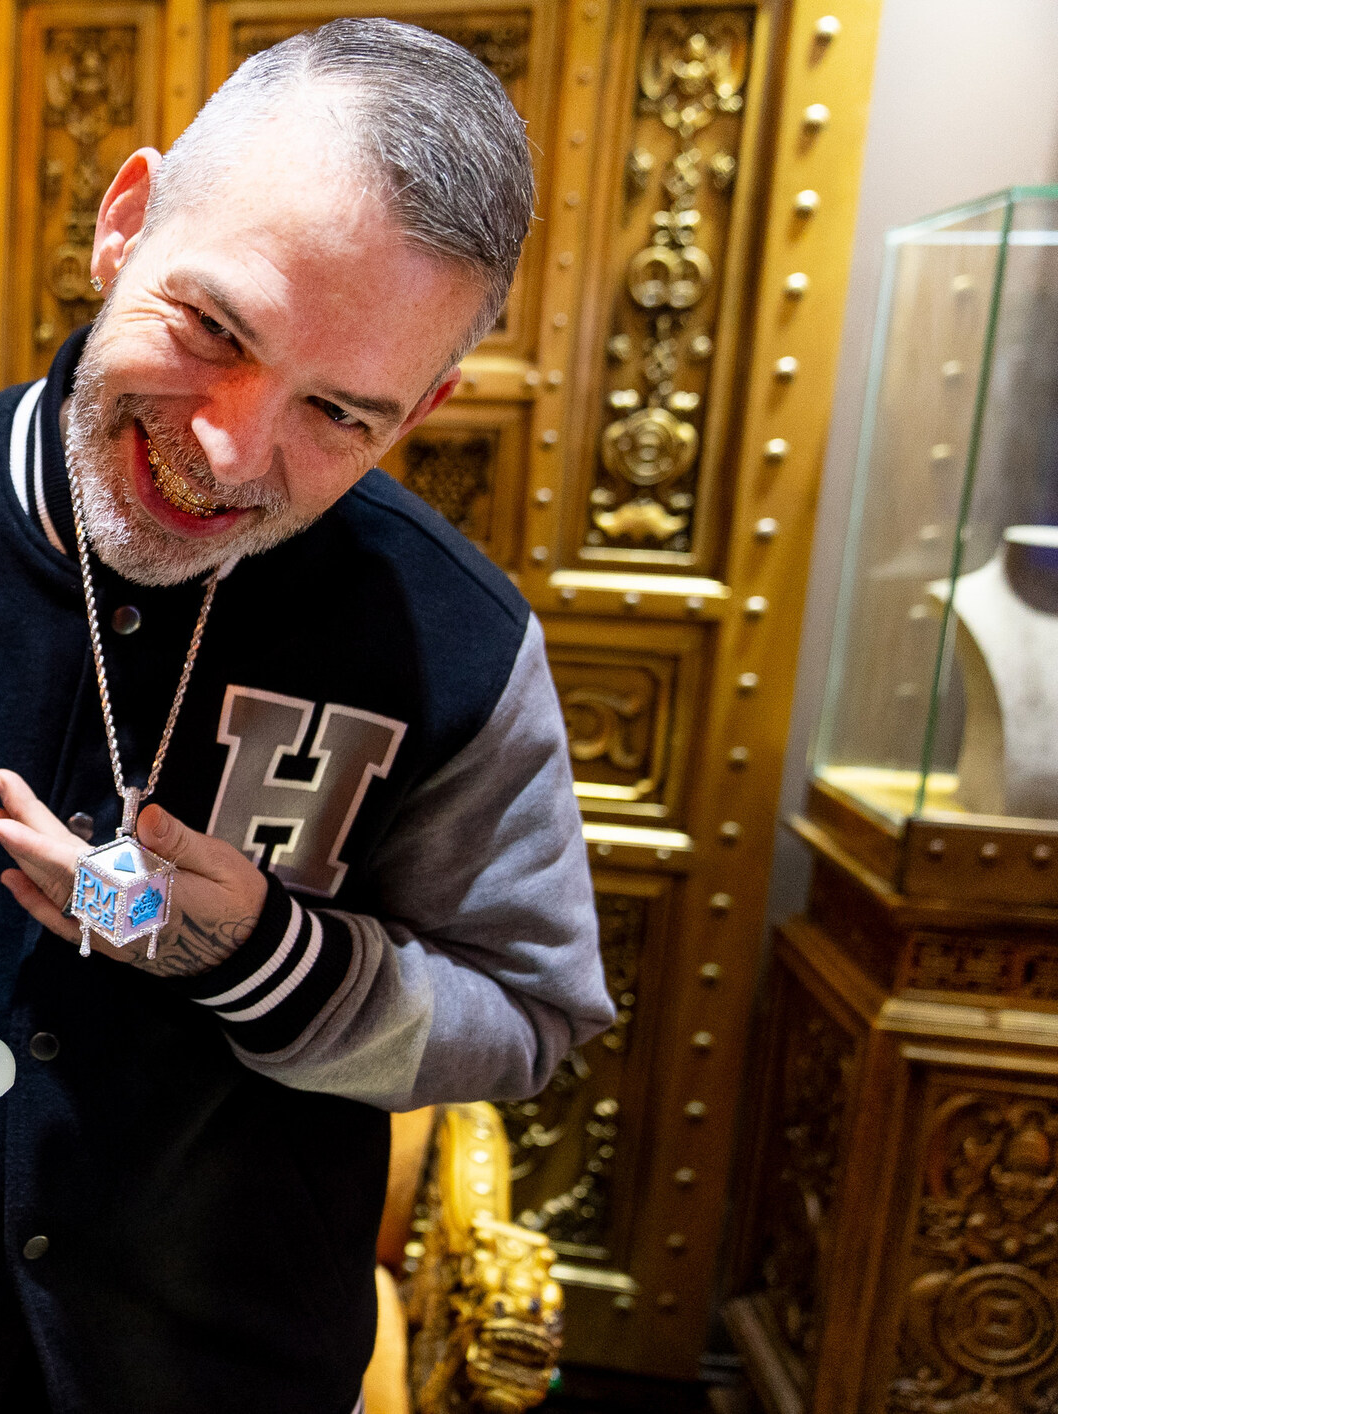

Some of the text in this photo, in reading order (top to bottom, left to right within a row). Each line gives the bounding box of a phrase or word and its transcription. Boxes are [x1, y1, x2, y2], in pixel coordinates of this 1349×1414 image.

[206, 684, 408, 899] H
[76, 893, 114, 931] ICE
[77, 867, 118, 914] PM
